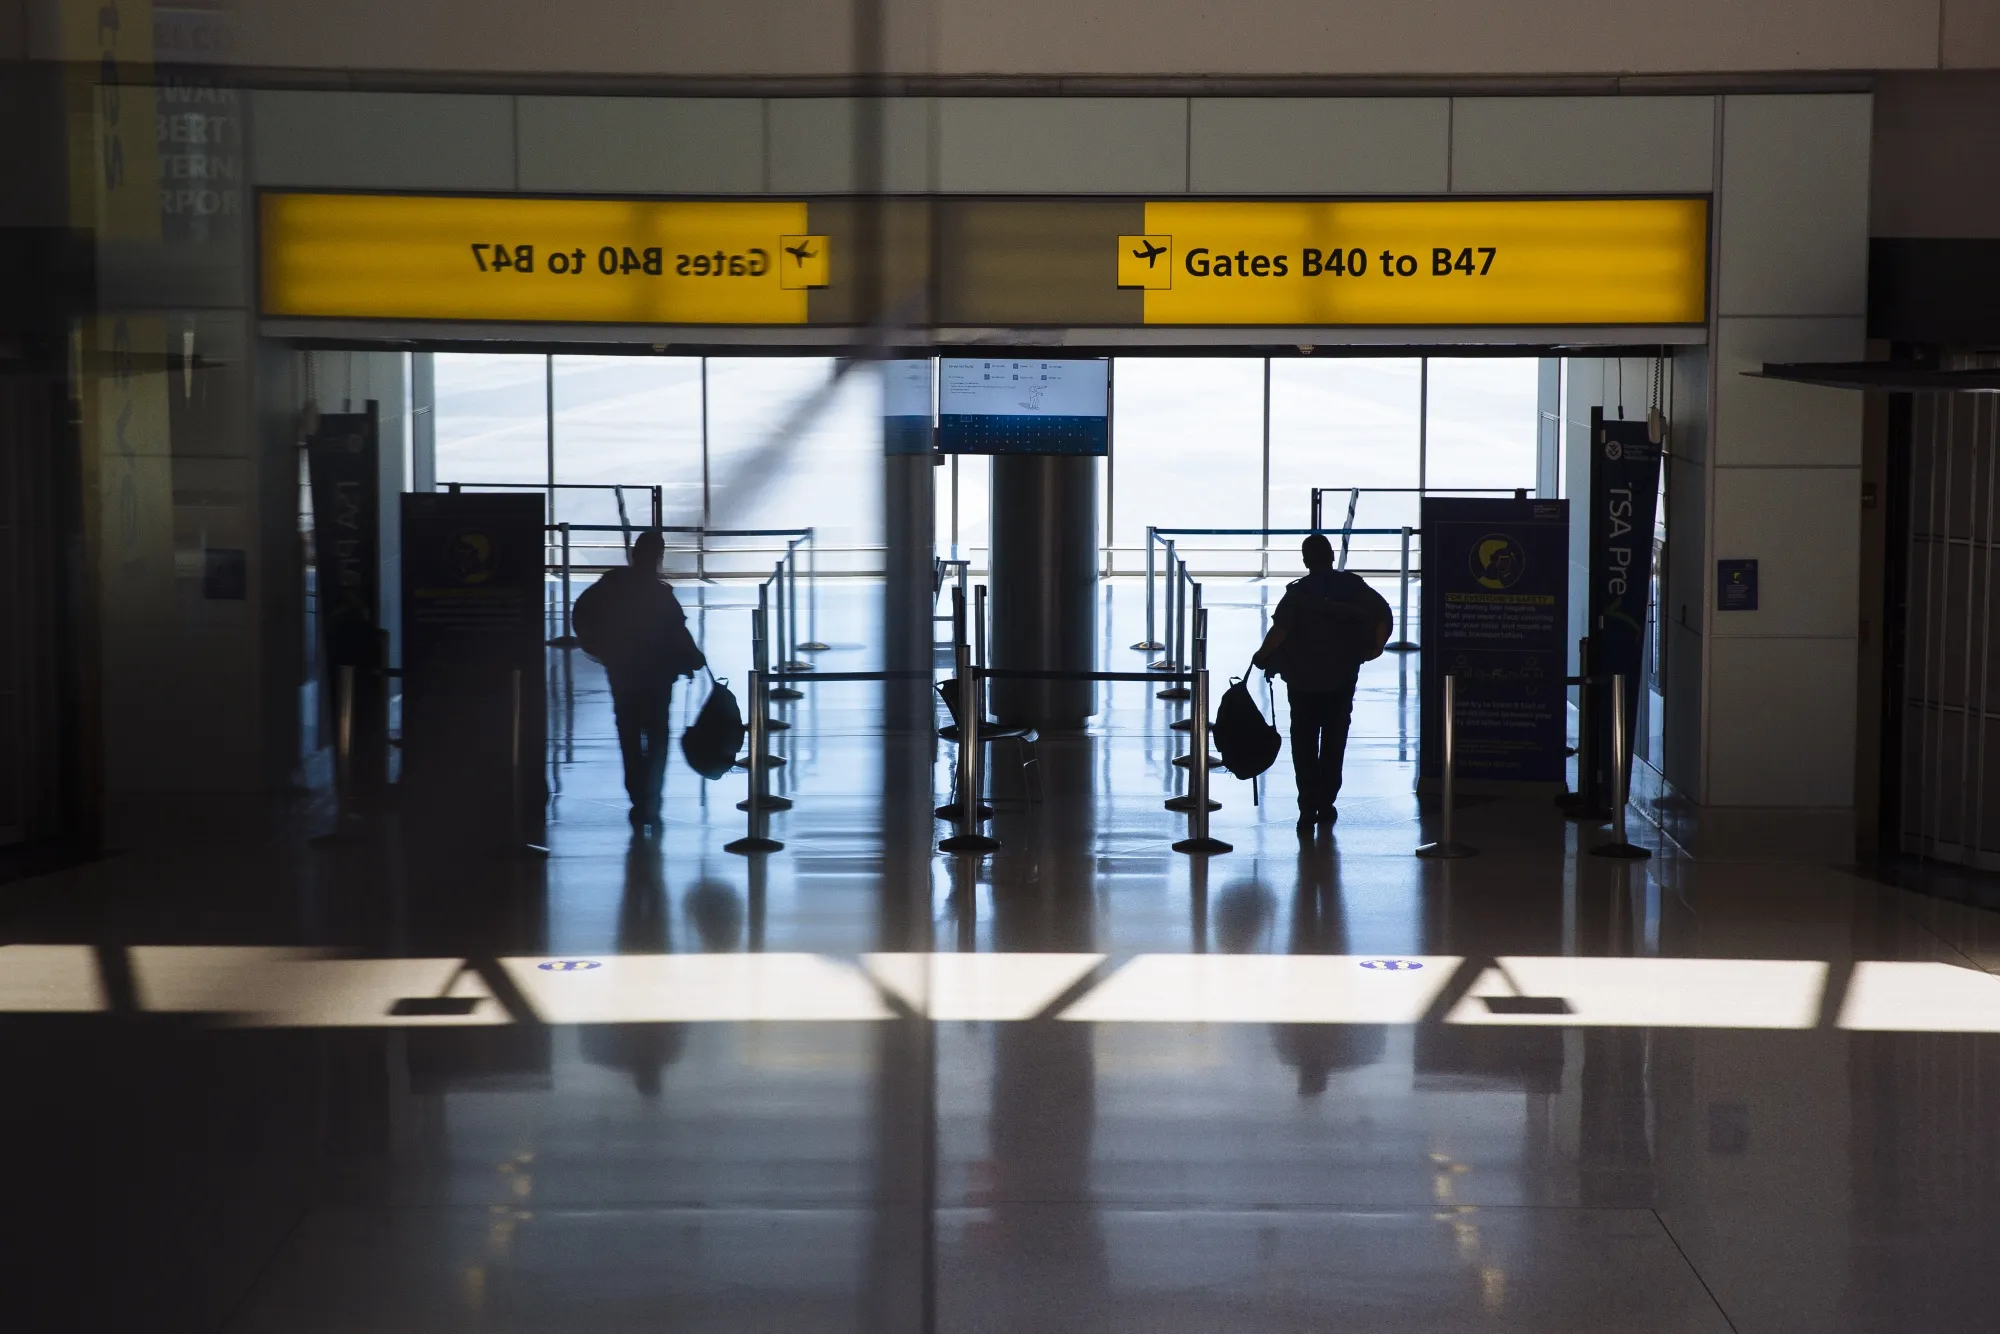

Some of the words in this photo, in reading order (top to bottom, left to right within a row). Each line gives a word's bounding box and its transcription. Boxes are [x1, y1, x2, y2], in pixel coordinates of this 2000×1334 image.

[1185, 247, 1288, 278] Gates
[1302, 247, 1367, 277] B40
[1380, 249, 1418, 277] to
[1432, 247, 1497, 276] B47
[1608, 481, 1632, 539] TSA
[1608, 548, 1632, 596] Pre
